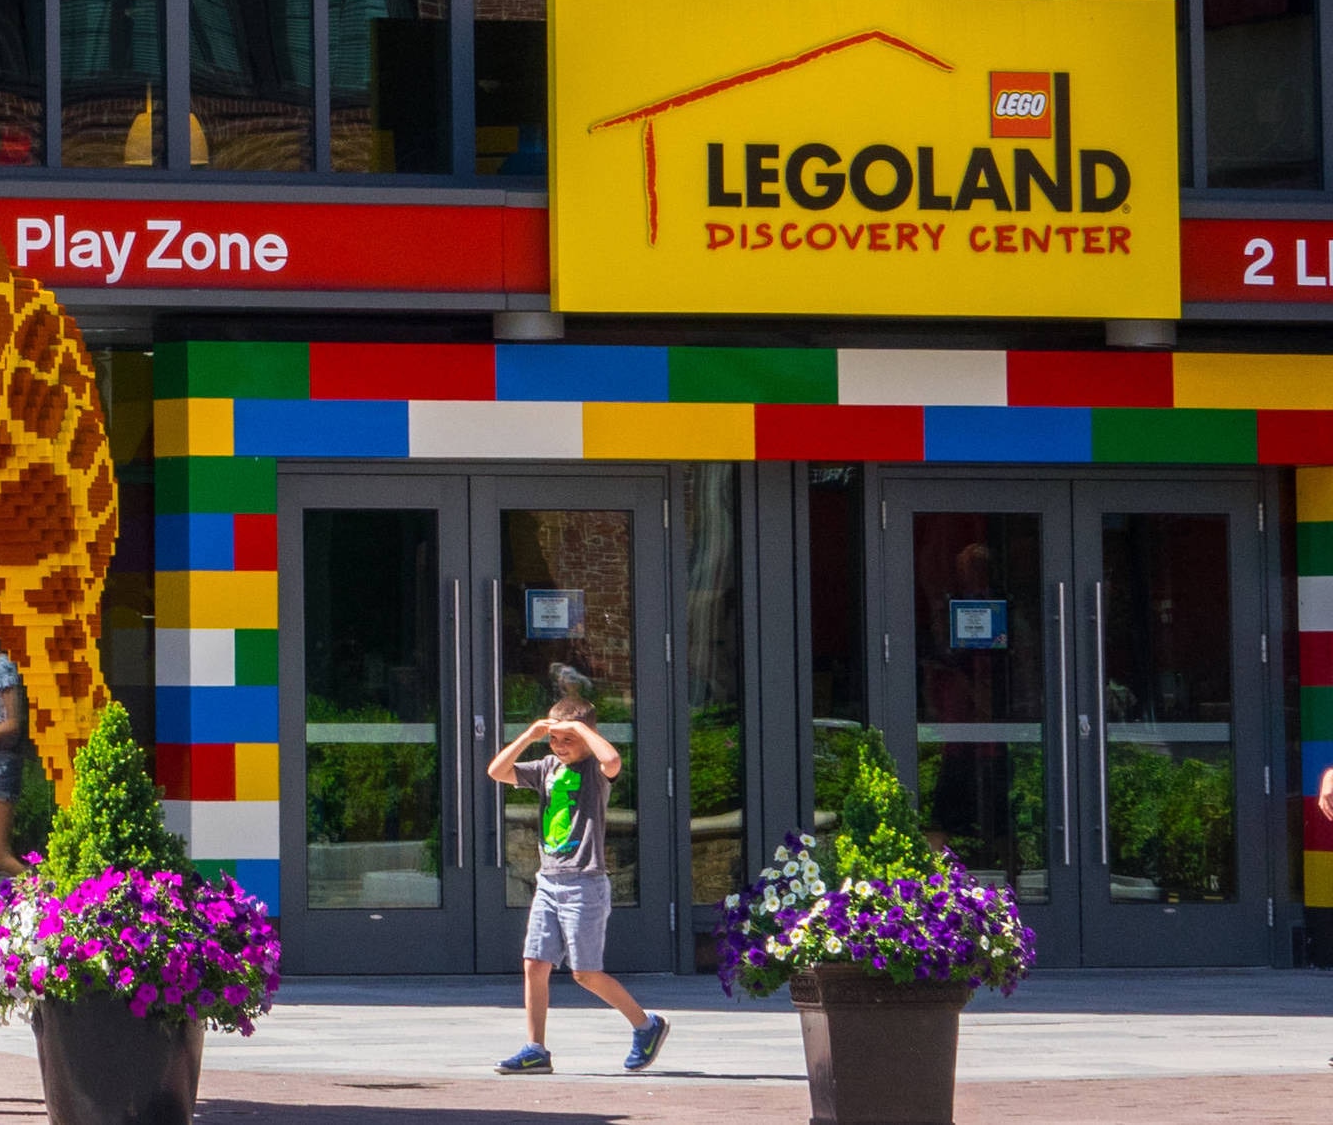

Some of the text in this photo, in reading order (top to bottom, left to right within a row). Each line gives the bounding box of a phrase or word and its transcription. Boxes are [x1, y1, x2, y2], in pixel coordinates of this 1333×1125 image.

[995, 91, 1046, 118] LEGO
[16, 215, 288, 284] Play Zone
[706, 221, 1131, 255] DISCOVERY CENTER
[1244, 238, 1333, 286] 2 L
